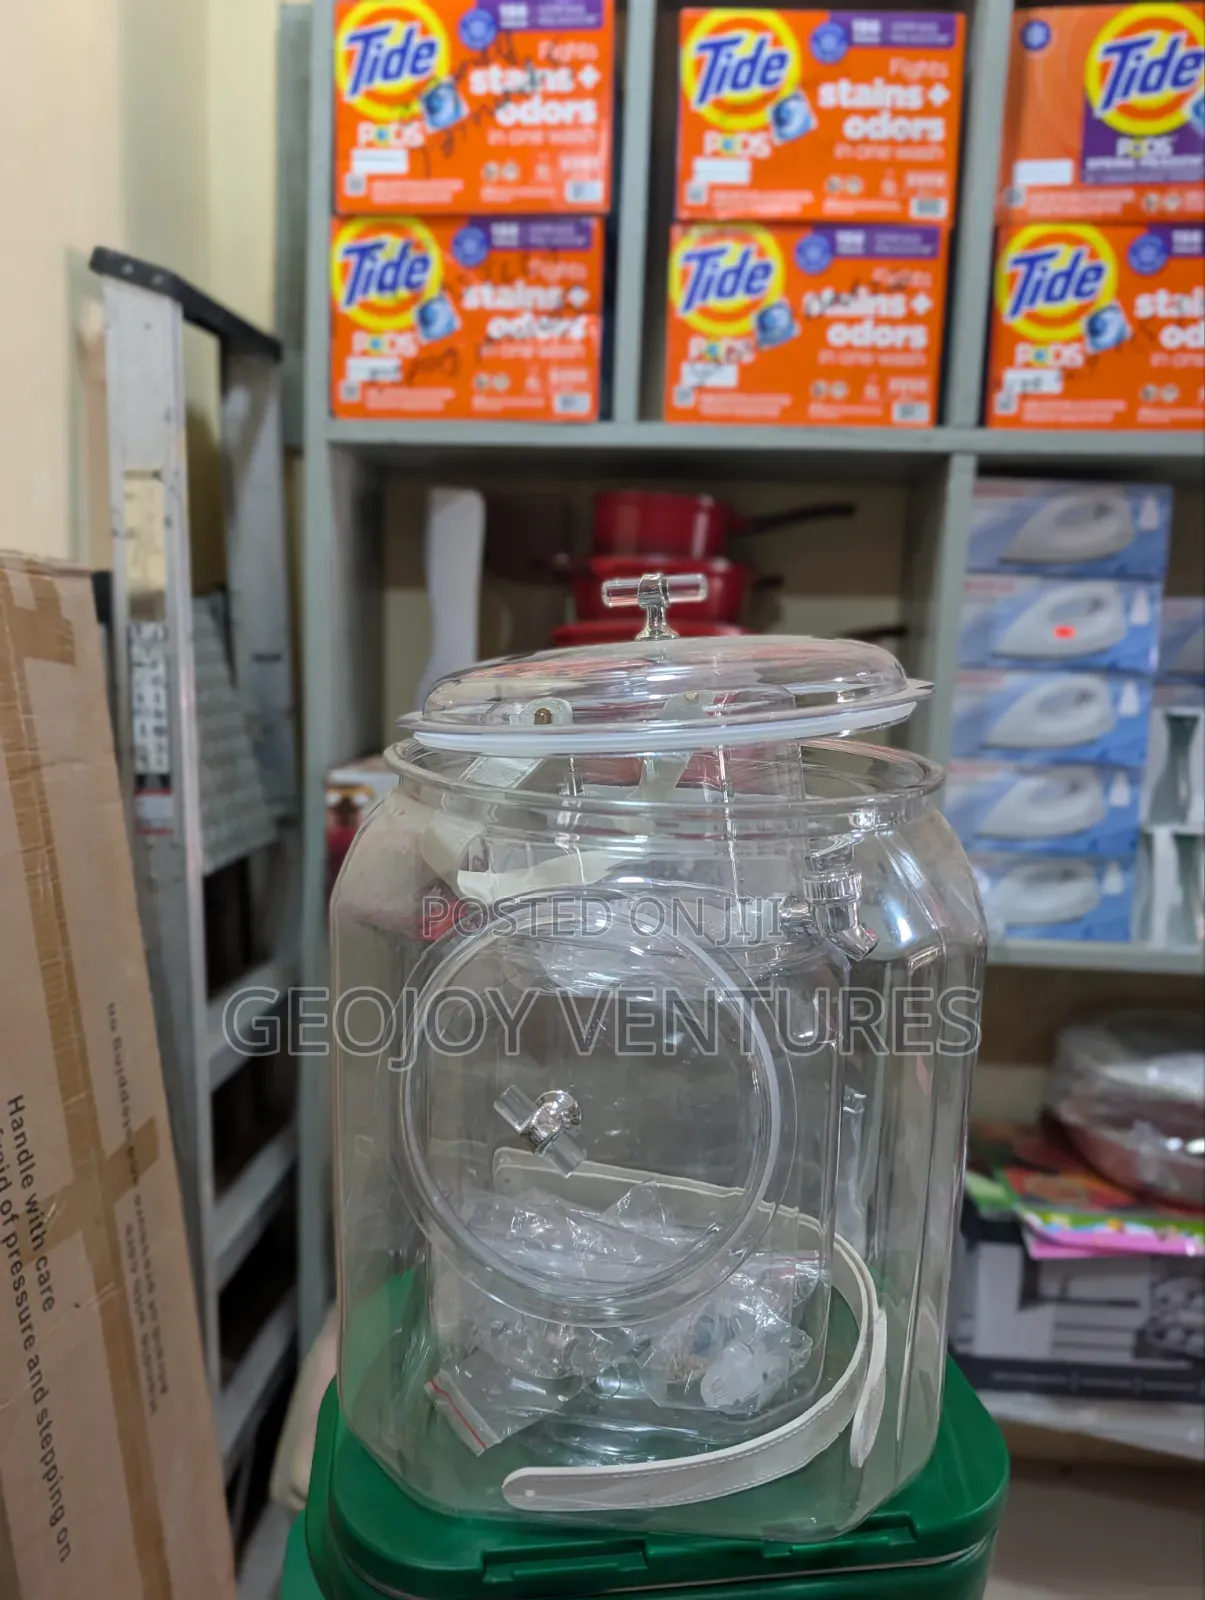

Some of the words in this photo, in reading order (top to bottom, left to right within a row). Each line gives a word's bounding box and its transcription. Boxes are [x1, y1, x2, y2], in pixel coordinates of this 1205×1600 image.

[345, 25, 438, 99] Tide
[469, 66, 574, 94] stains
[696, 35, 790, 107] Tide
[1101, 35, 1205, 112] Tide
[494, 94, 597, 125] odors
[818, 78, 924, 110] stains
[843, 109, 946, 141] odors
[342, 241, 431, 309] Tide
[462, 280, 565, 309] stains
[682, 246, 774, 313] Tide
[1010, 248, 1106, 318] Tide
[487, 312, 588, 339] odors
[826, 317, 929, 349] odors
[7, 1094, 36, 1190] Handle
[0, 1199, 20, 1227] of
[25, 1192, 47, 1252] with
[1, 1231, 37, 1351] pressure
[35, 1255, 56, 1313] care
[27, 1354, 49, 1405] and
[36, 1408, 66, 1528] stepping
[56, 1527, 72, 1563] on
